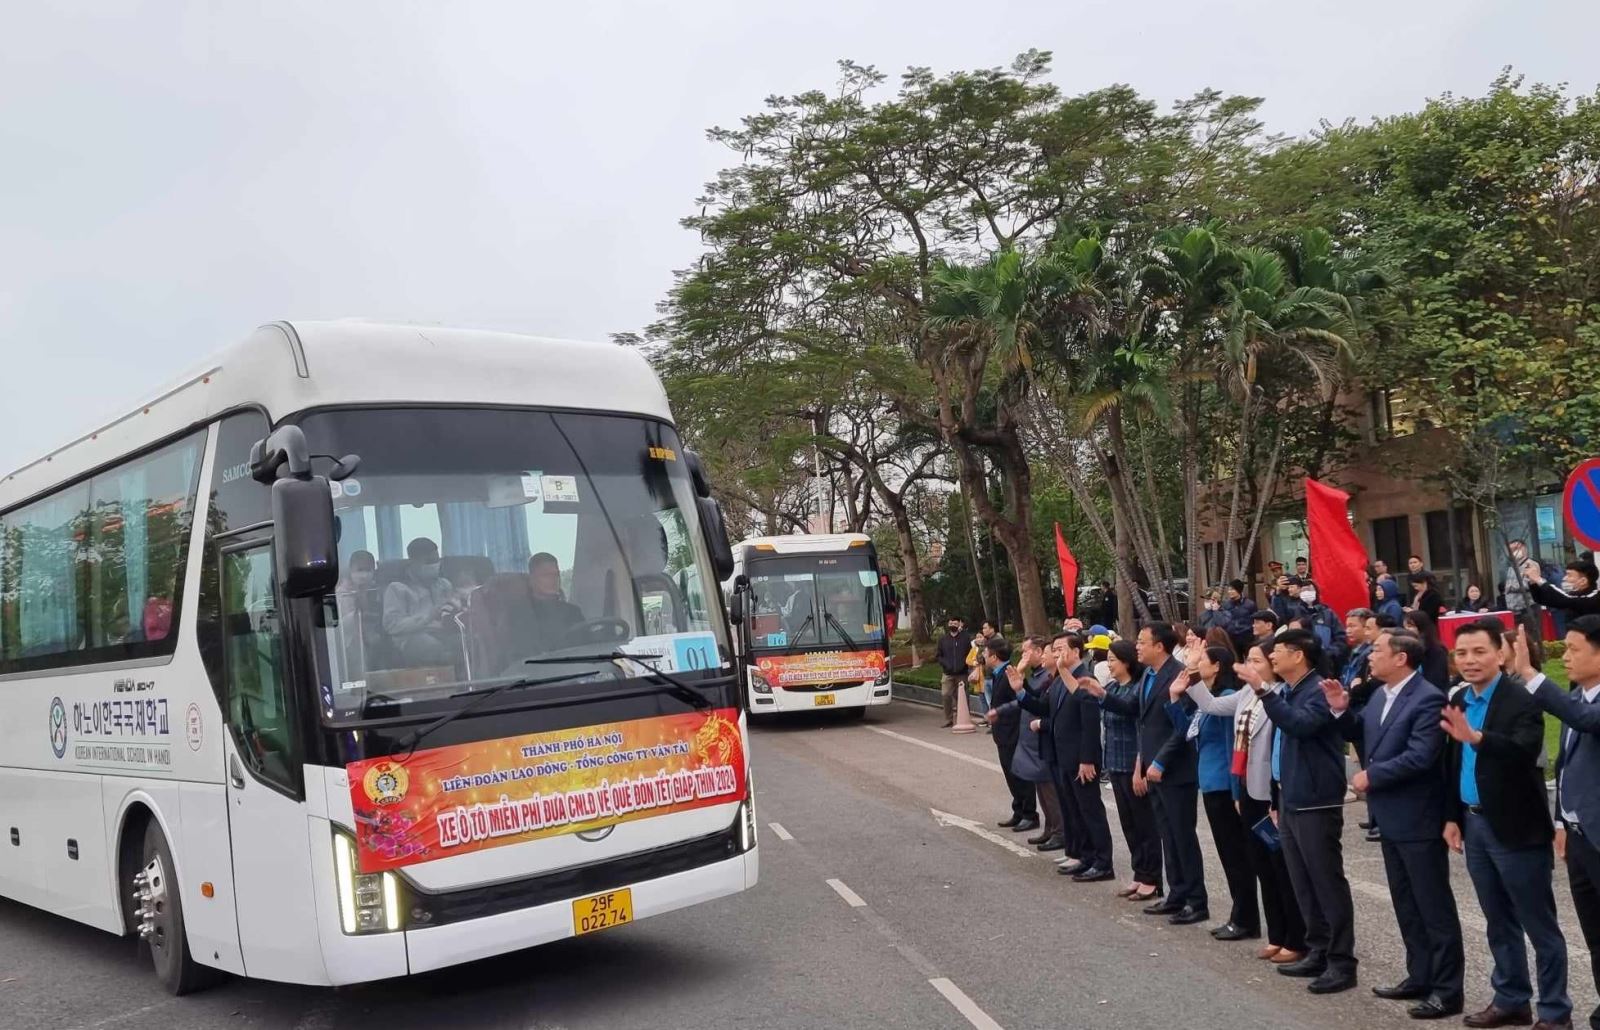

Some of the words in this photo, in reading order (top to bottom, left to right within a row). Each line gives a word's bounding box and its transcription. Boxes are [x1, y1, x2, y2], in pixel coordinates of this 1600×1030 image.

[773, 637, 784, 645] 16
[686, 646, 709, 670] 01
[73, 698, 169, 736] 하노이한국국제학교
[563, 736, 584, 751] PHỐ
[587, 735, 602, 748] HÀ
[603, 732, 623, 747] NỘI
[75, 745, 91, 760] KOREAN
[92, 746, 126, 762] INTERNATIONAL
[126, 747, 147, 764] SCHOOL
[147, 748, 154, 764] IN
[443, 774, 471, 791] LIÊN
[475, 770, 508, 786] ĐOÀN
[511, 768, 534, 780] LAO
[537, 761, 568, 776] ĐỘNG
[576, 752, 604, 769] TỔNG
[607, 751, 634, 764] CÔNG
[636, 749, 649, 759] TY
[651, 744, 671, 758] VẬN
[672, 740, 688, 754] TẢI
[440, 817, 457, 842] XE
[459, 808, 470, 838] Ô
[471, 806, 486, 835] TÔ
[489, 798, 520, 832] MIỄN
[522, 795, 541, 827] PHÍ
[543, 797, 567, 823] ĐƯA
[568, 793, 596, 816] CNLĐ
[598, 782, 611, 812] VỀ
[612, 781, 632, 812] QUÊ
[634, 777, 653, 806] ĐÓN
[655, 773, 672, 801] TẾT
[673, 772, 693, 798] GIÁP
[695, 767, 715, 795] THÌN
[716, 769, 735, 792] 2024
[591, 894, 614, 913] 29F
[582, 908, 626, 932] 022.74
